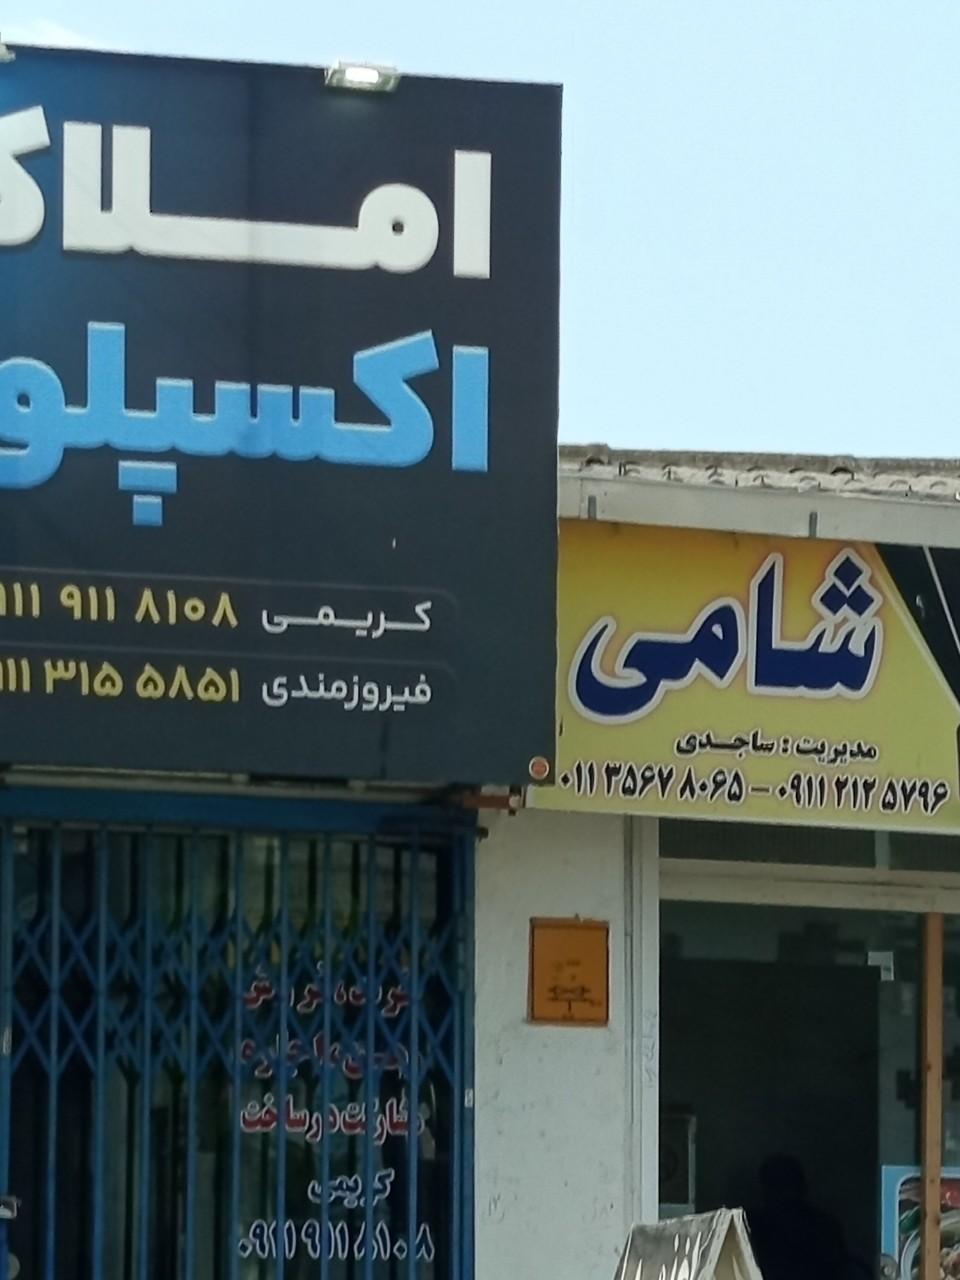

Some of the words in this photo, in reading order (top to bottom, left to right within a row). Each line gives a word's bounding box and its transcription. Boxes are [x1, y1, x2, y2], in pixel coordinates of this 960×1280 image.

[262, 601, 432, 639] کریمی
[570, 550, 883, 722] شامی
[262, 673, 432, 711] فیروزمندی
[675, 729, 776, 759] ساجدی
